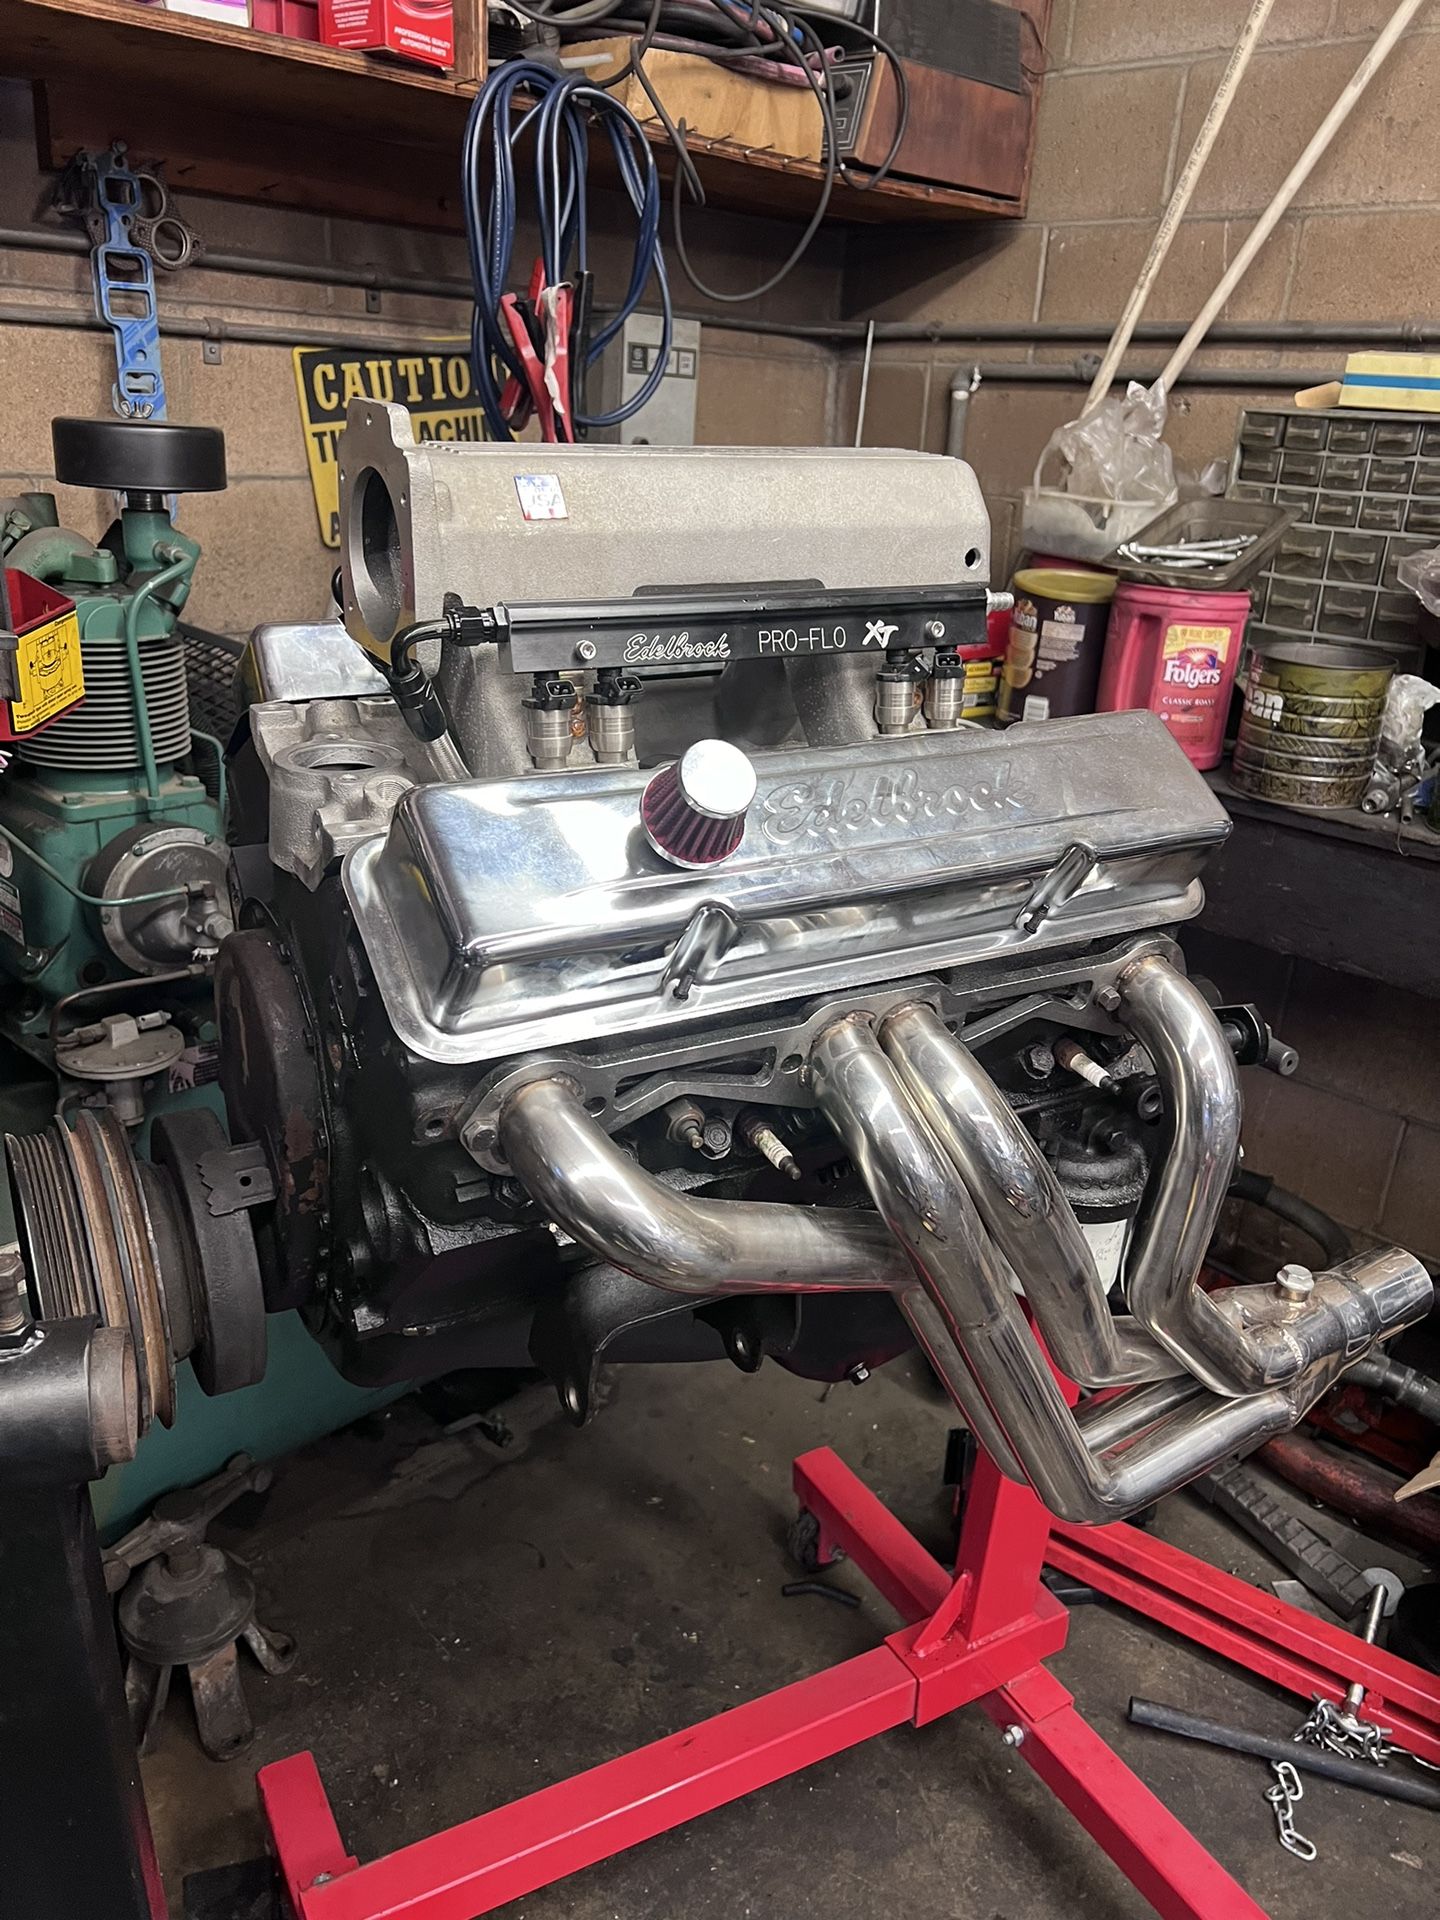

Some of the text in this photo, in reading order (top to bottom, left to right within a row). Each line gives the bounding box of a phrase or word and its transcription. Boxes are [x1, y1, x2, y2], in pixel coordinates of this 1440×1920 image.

[313, 355, 509, 412] CAUTIO
[623, 631, 731, 663] Edelbrock
[758, 626, 847, 653] PRO-FLO
[1163, 659, 1221, 688] Folgers
[1162, 695, 1192, 706] CLASSIC
[762, 761, 1034, 844] Edelbrock
